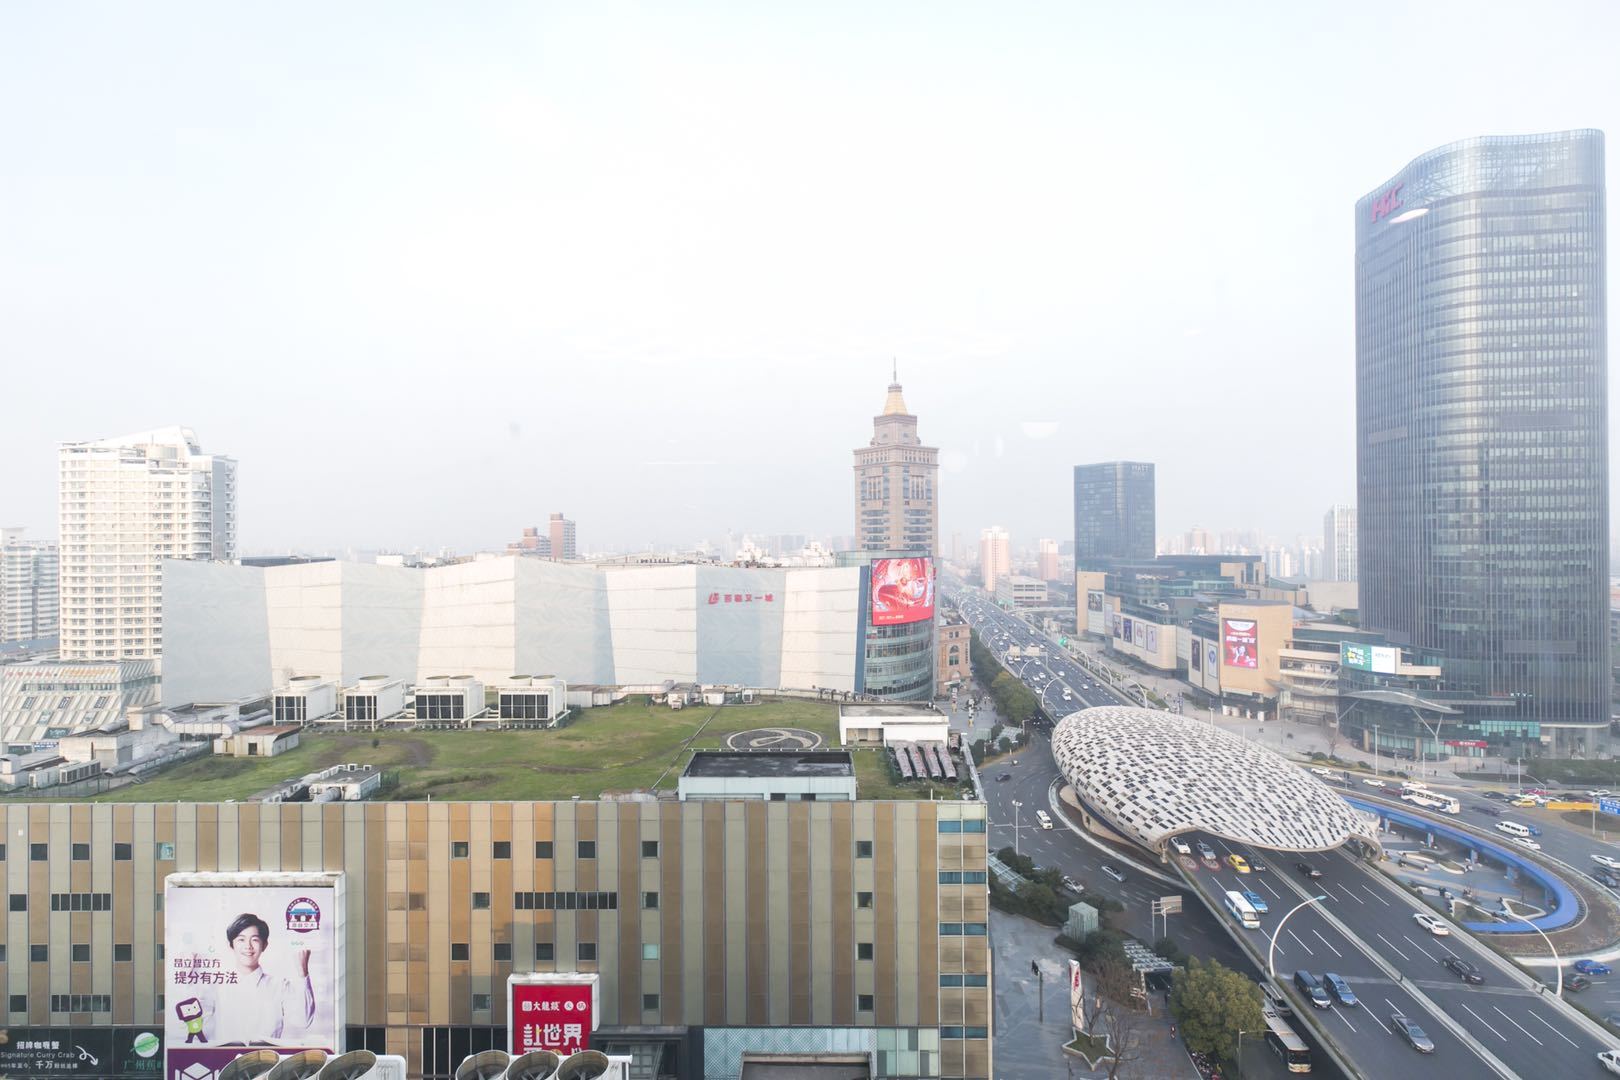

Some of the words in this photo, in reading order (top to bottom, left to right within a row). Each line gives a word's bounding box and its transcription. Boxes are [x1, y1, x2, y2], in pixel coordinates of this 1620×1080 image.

[174, 958, 221, 968] 昂立智立方
[174, 971, 238, 984] 提分有方法
[1, 1051, 34, 1059] Signature
